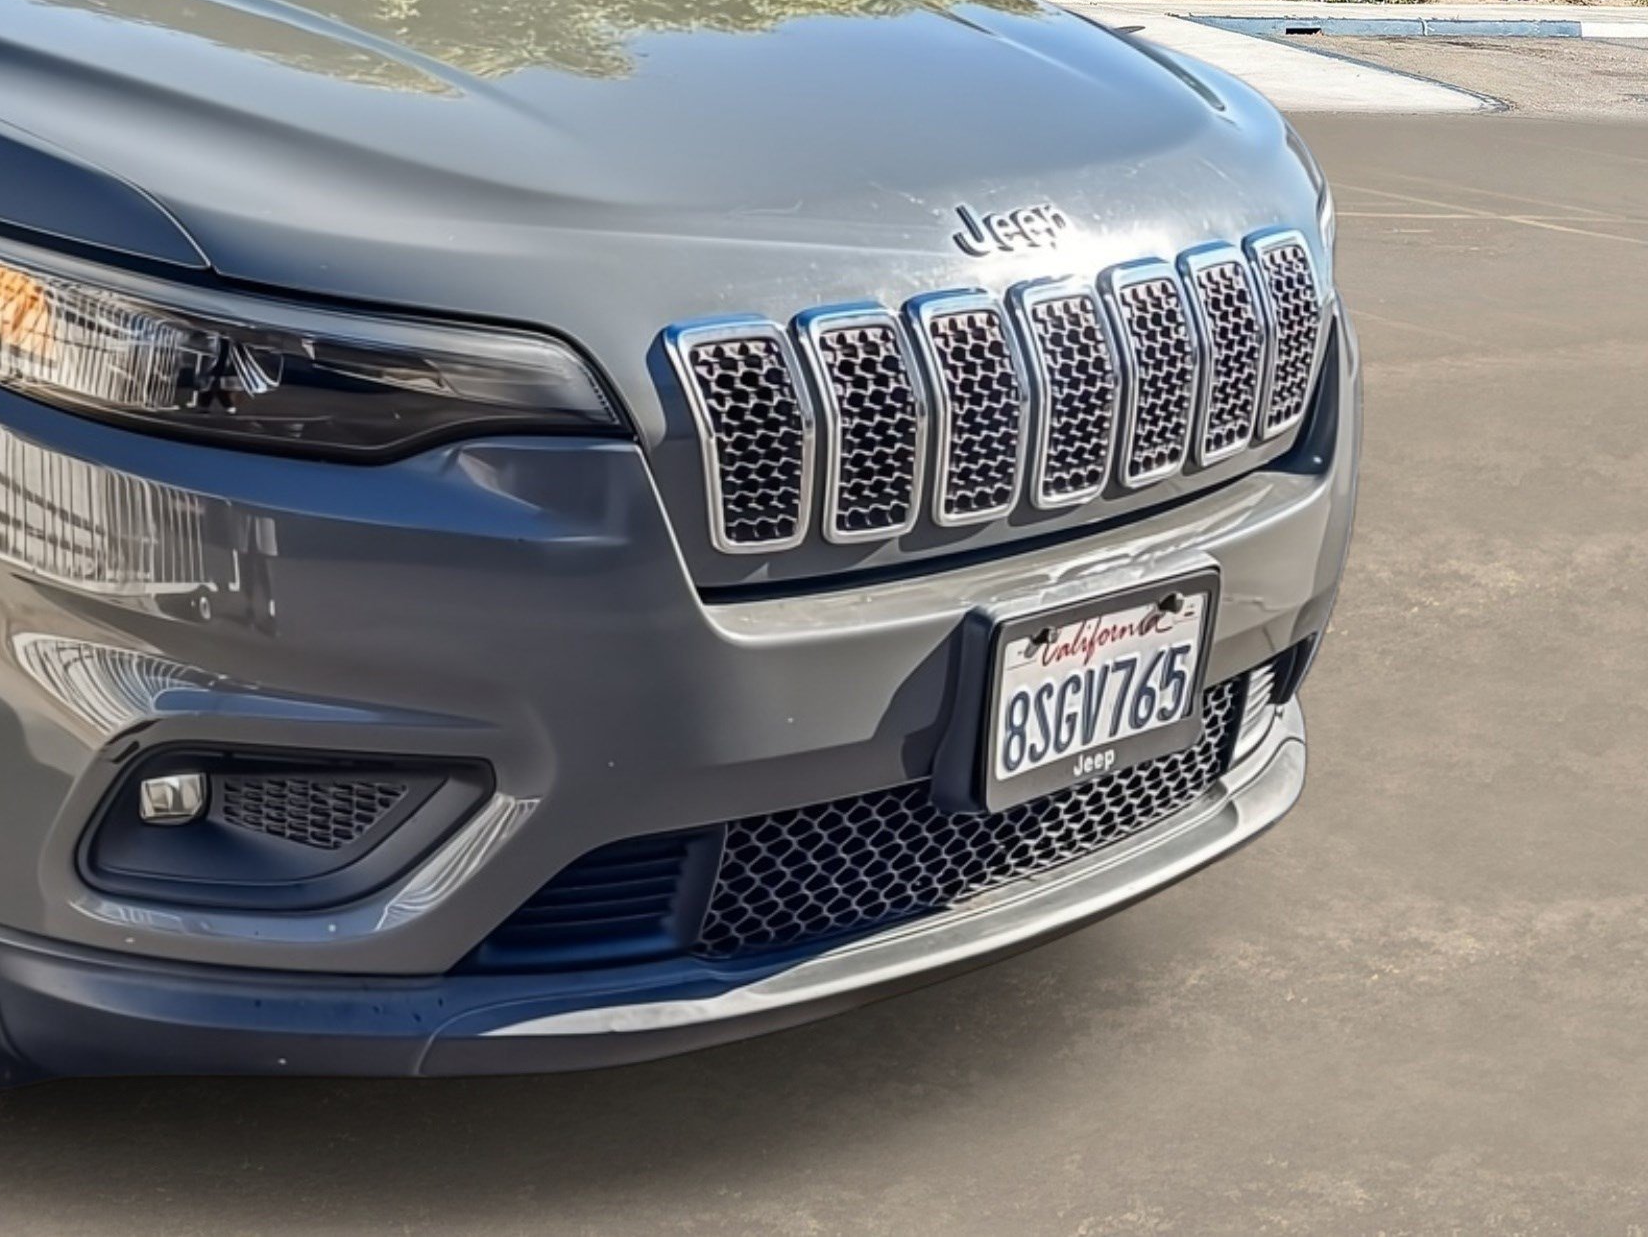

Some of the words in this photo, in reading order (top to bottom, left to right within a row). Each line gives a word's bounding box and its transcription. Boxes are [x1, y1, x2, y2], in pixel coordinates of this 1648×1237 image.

[952, 204, 1068, 258] Jeep
[1002, 644, 1192, 773] 8SGV765
[1072, 749, 1115, 777] Jeep
